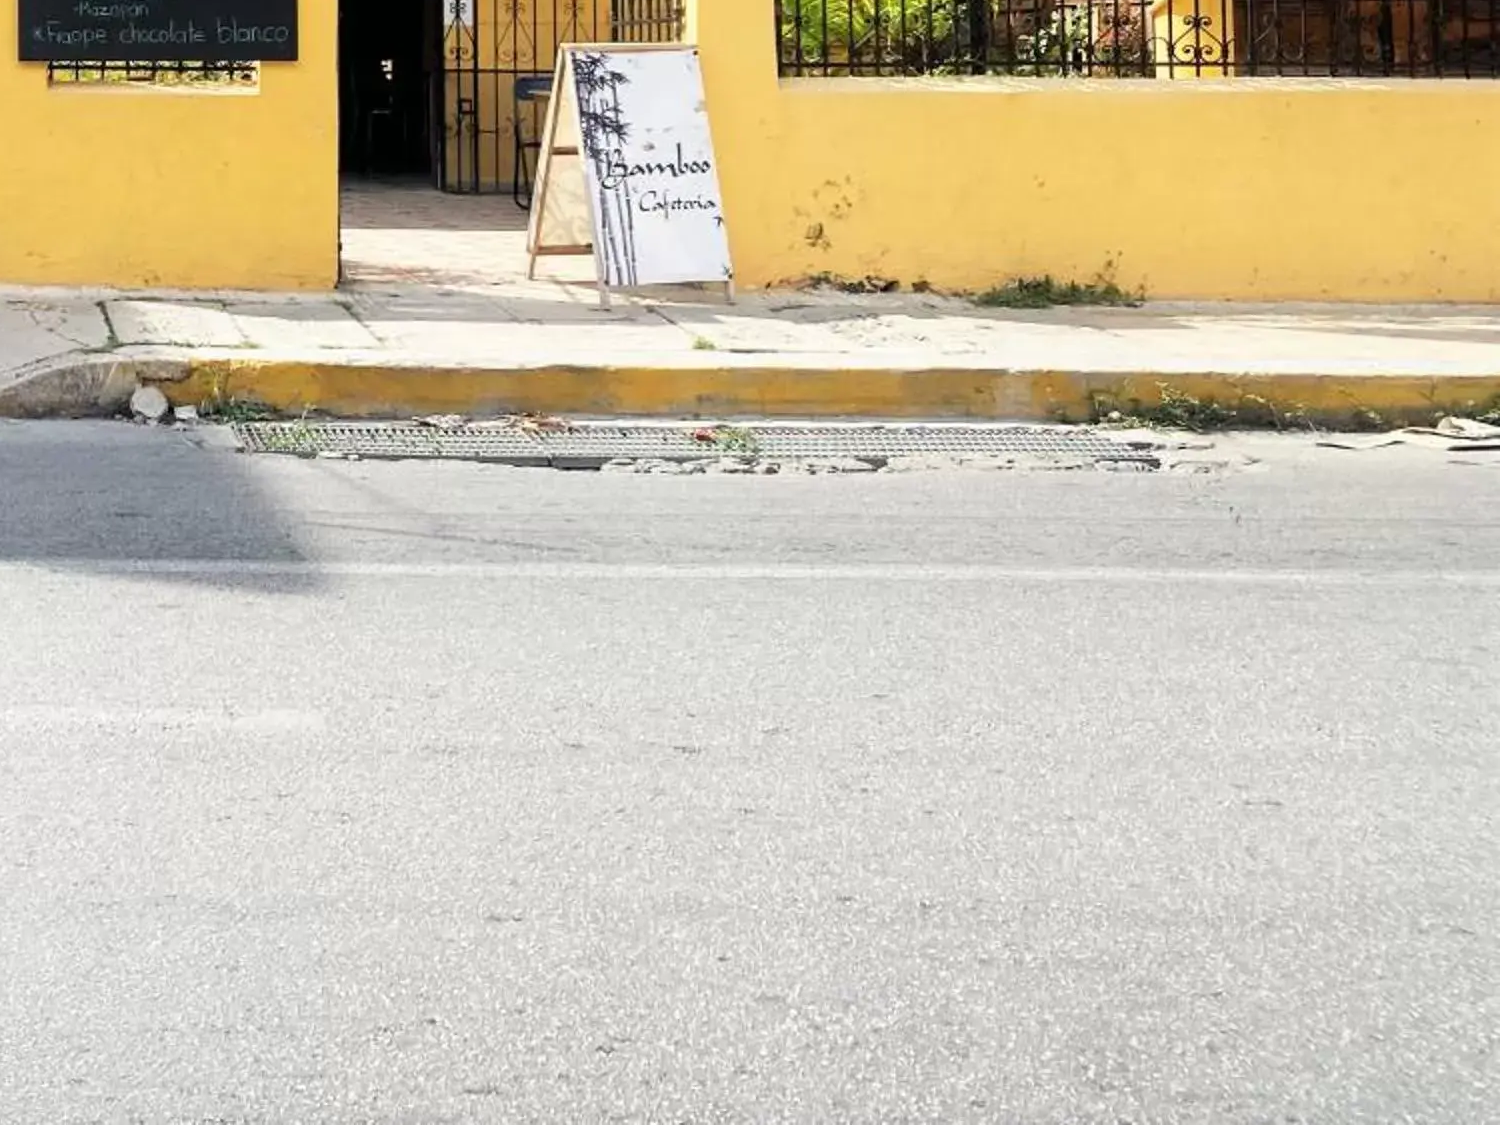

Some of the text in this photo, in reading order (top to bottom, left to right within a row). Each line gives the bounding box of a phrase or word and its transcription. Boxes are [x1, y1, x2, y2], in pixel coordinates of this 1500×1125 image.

[118, 22, 207, 45] chocolate
[217, 16, 290, 44] blanco
[601, 142, 711, 189] Bamboo
